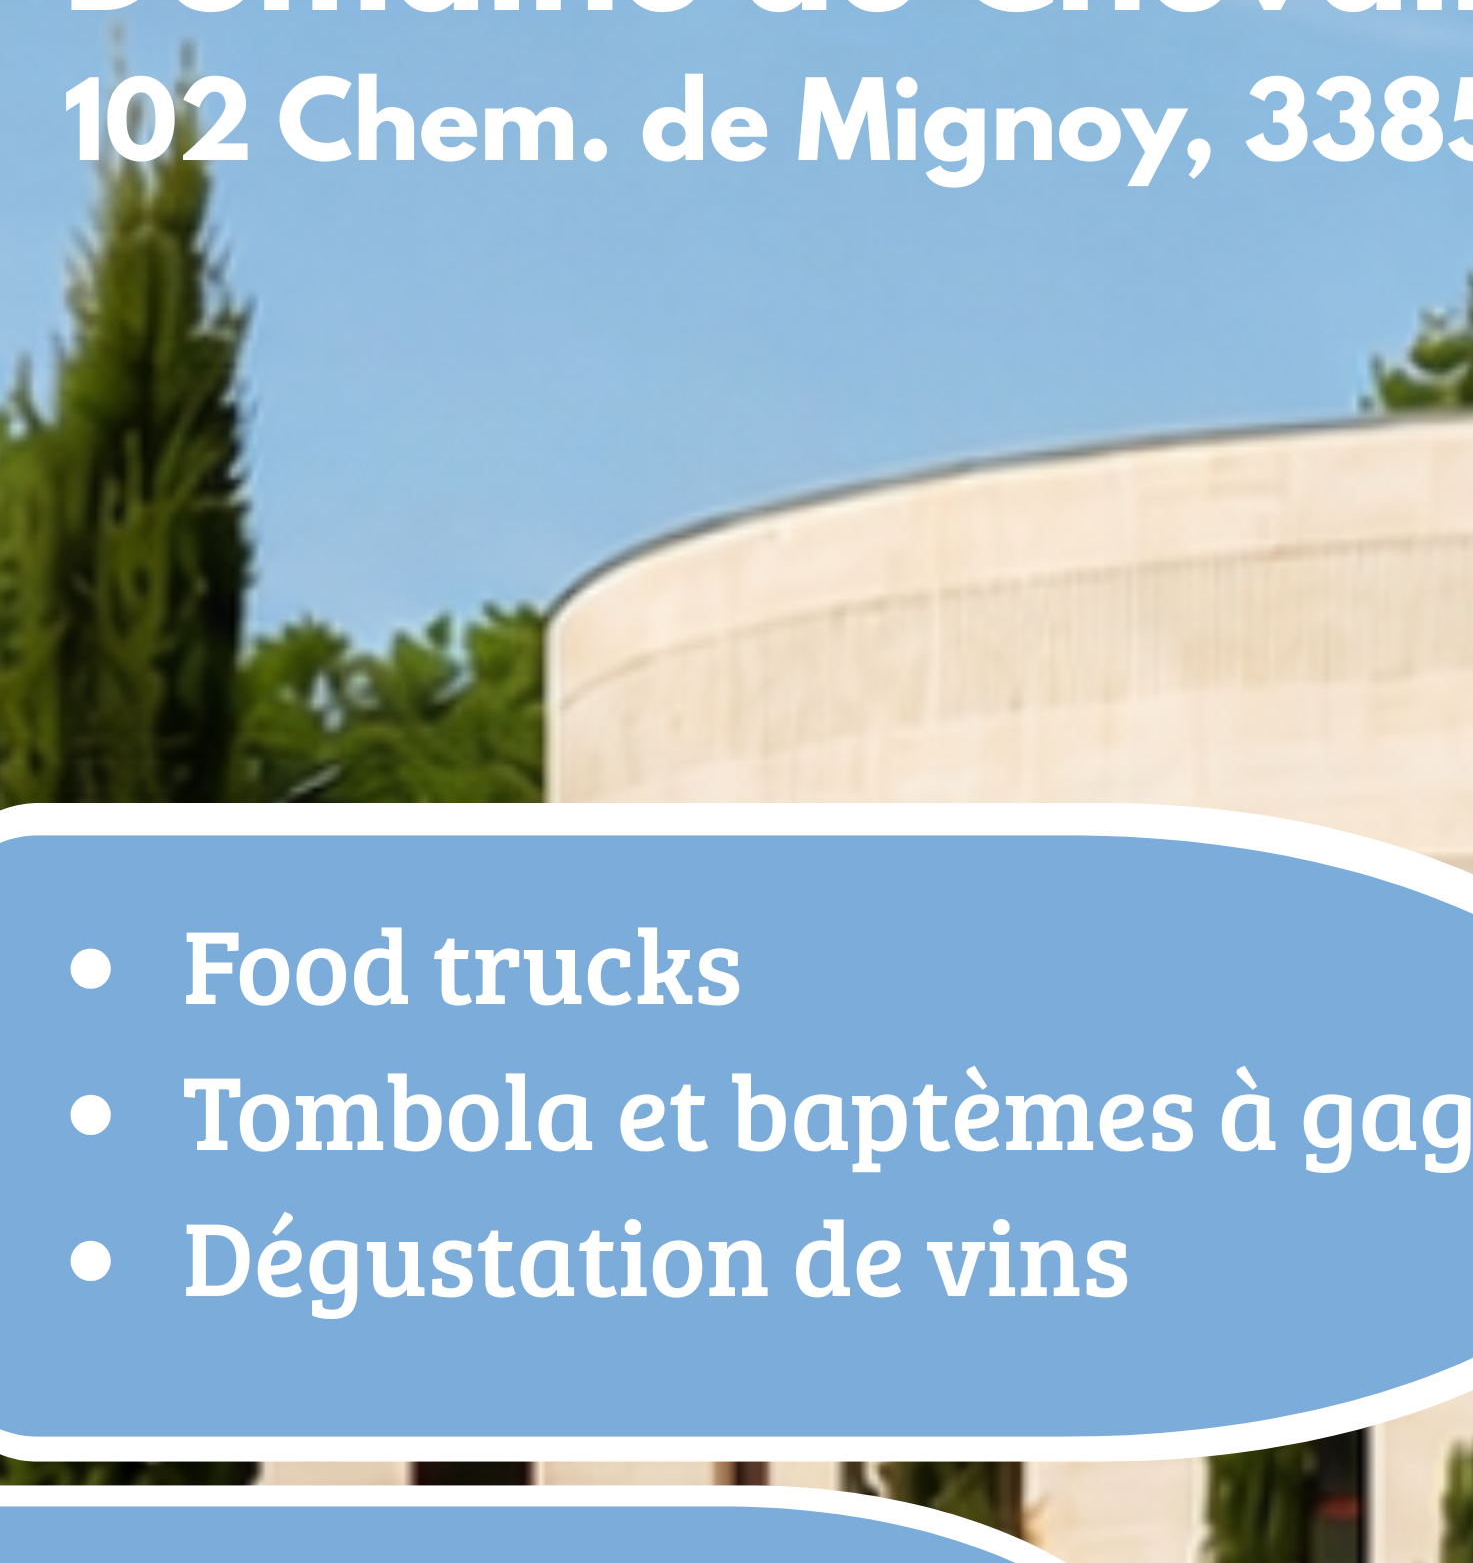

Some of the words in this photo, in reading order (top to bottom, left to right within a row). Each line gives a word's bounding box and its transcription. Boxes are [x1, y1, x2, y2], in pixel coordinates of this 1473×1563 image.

[65, 75, 248, 162] 102
[279, 73, 608, 162] Chem.
[642, 73, 768, 162] de
[798, 74, 1211, 188] Mignoy,
[185, 927, 409, 1006] Food
[433, 927, 740, 1006] trucks
[183, 1073, 593, 1152] Tombola
[620, 1084, 709, 1152] et
[731, 1065, 1194, 1173] baptèmes
[1221, 1065, 1276, 1152] à
[185, 1211, 768, 1320] Dégustation
[795, 1219, 902, 1298] de
[926, 1218, 1128, 1298] vins
